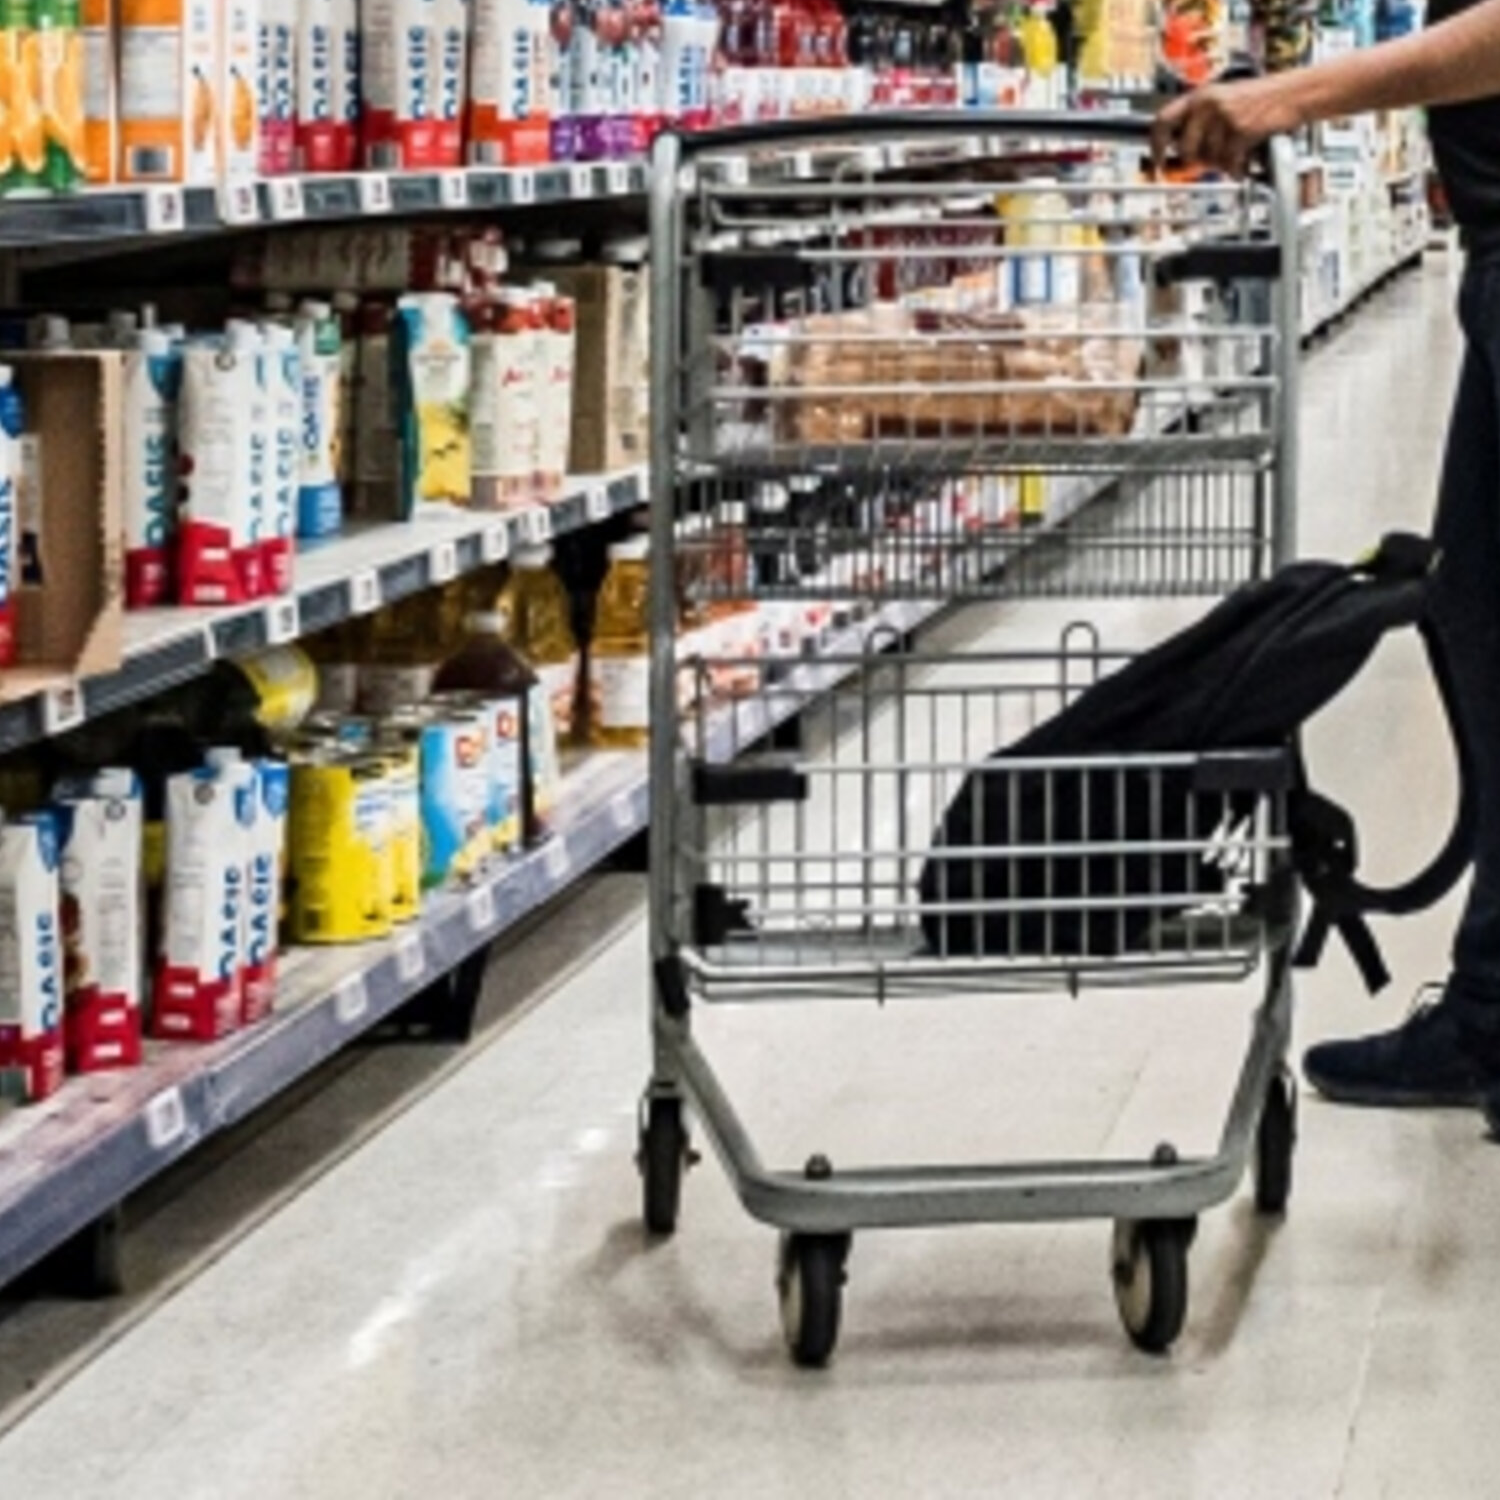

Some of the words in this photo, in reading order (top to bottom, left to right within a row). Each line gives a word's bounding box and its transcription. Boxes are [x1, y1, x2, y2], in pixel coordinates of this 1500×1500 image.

[219, 866, 241, 982] OASIS
[248, 853, 272, 967] OASIS
[36, 912, 58, 1032] OASIS
